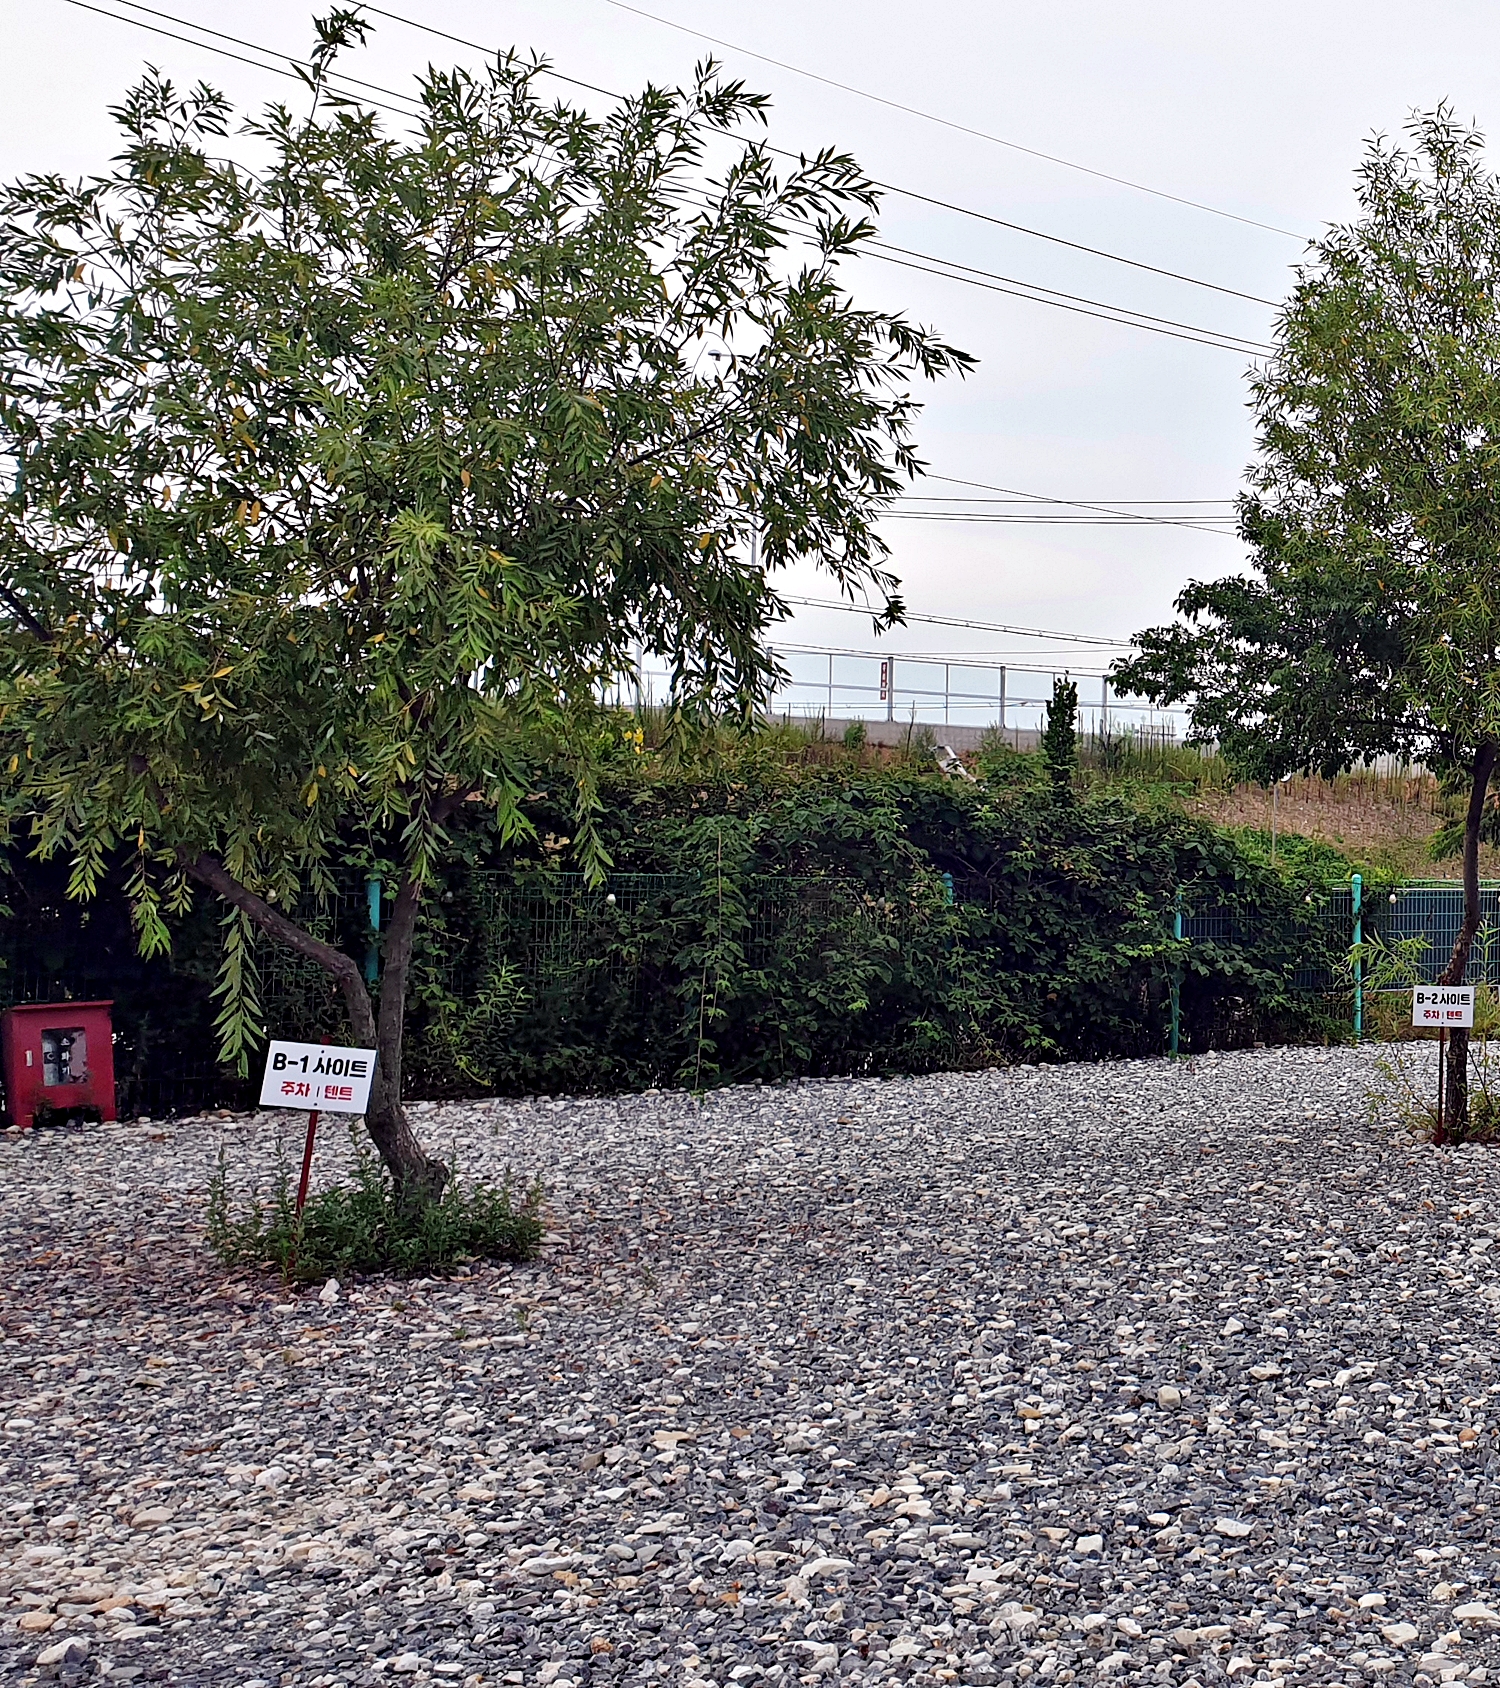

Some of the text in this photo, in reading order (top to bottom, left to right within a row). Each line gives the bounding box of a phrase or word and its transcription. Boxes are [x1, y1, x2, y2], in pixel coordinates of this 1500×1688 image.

[1417, 992, 1471, 1006] B-2 사이트
[1423, 1010, 1463, 1020] 주차 텐트
[272, 1052, 368, 1078] B-1 사이트
[281, 1081, 353, 1101] 주차 텐트
